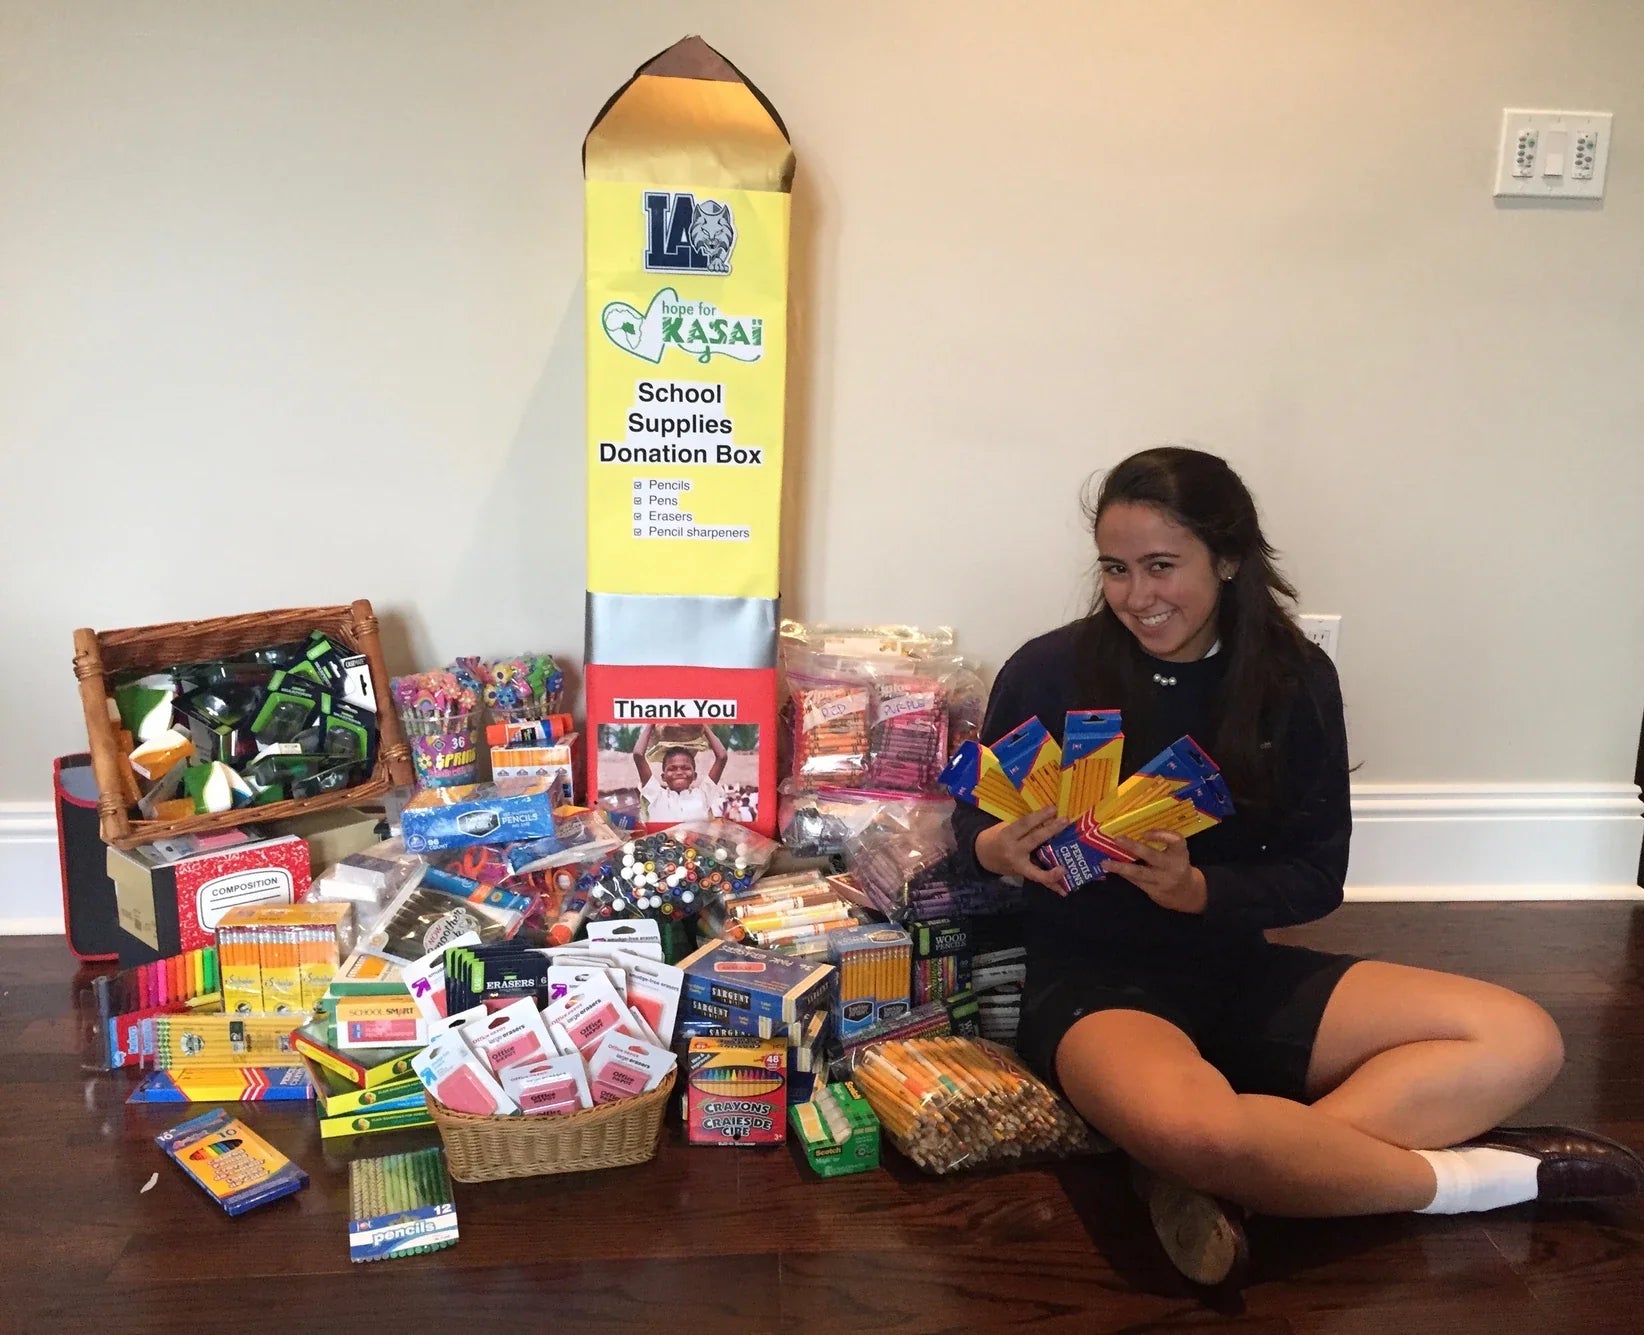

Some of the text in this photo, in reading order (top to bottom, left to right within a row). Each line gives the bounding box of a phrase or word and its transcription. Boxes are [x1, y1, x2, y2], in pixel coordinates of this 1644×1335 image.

[662, 301, 717, 317] hope for
[638, 382, 722, 403] School
[628, 413, 733, 438] Supplies
[599, 443, 762, 464] Donation Box
[649, 479, 690, 490] Pencils
[649, 495, 678, 506] Pens
[649, 511, 693, 522] Erasers
[649, 526, 750, 539] Pencil sharpeners
[614, 700, 735, 718] Thank You
[451, 736, 465, 749] 36
[501, 812, 538, 825] PENCILS
[1060, 846, 1084, 886] CRAYONS
[1069, 843, 1093, 880] PENCILS
[211, 876, 278, 897] COMPOSITION
[428, 925, 441, 945] NOW
[935, 932, 967, 945] WOOD
[486, 979, 535, 990] ERASERS
[711, 986, 750, 1004] SARGENT
[348, 1007, 414, 1017] SCHOOL SMART
[579, 999, 602, 1016] erasers
[692, 1000, 729, 1018] SARGENT
[502, 1024, 526, 1038] erasers
[580, 1018, 603, 1036] Office
[709, 1027, 752, 1037] SARGEN
[492, 1046, 515, 1060] Office
[766, 1055, 780, 1064] 48
[629, 1058, 651, 1070] erasers
[612, 1070, 635, 1083] Office
[704, 1101, 771, 1115] CRAYONS
[703, 1116, 773, 1131] CRAIES DE
[815, 1147, 842, 1157] Scotch
[434, 1203, 453, 1216] 12
[372, 1220, 436, 1247] pencils
